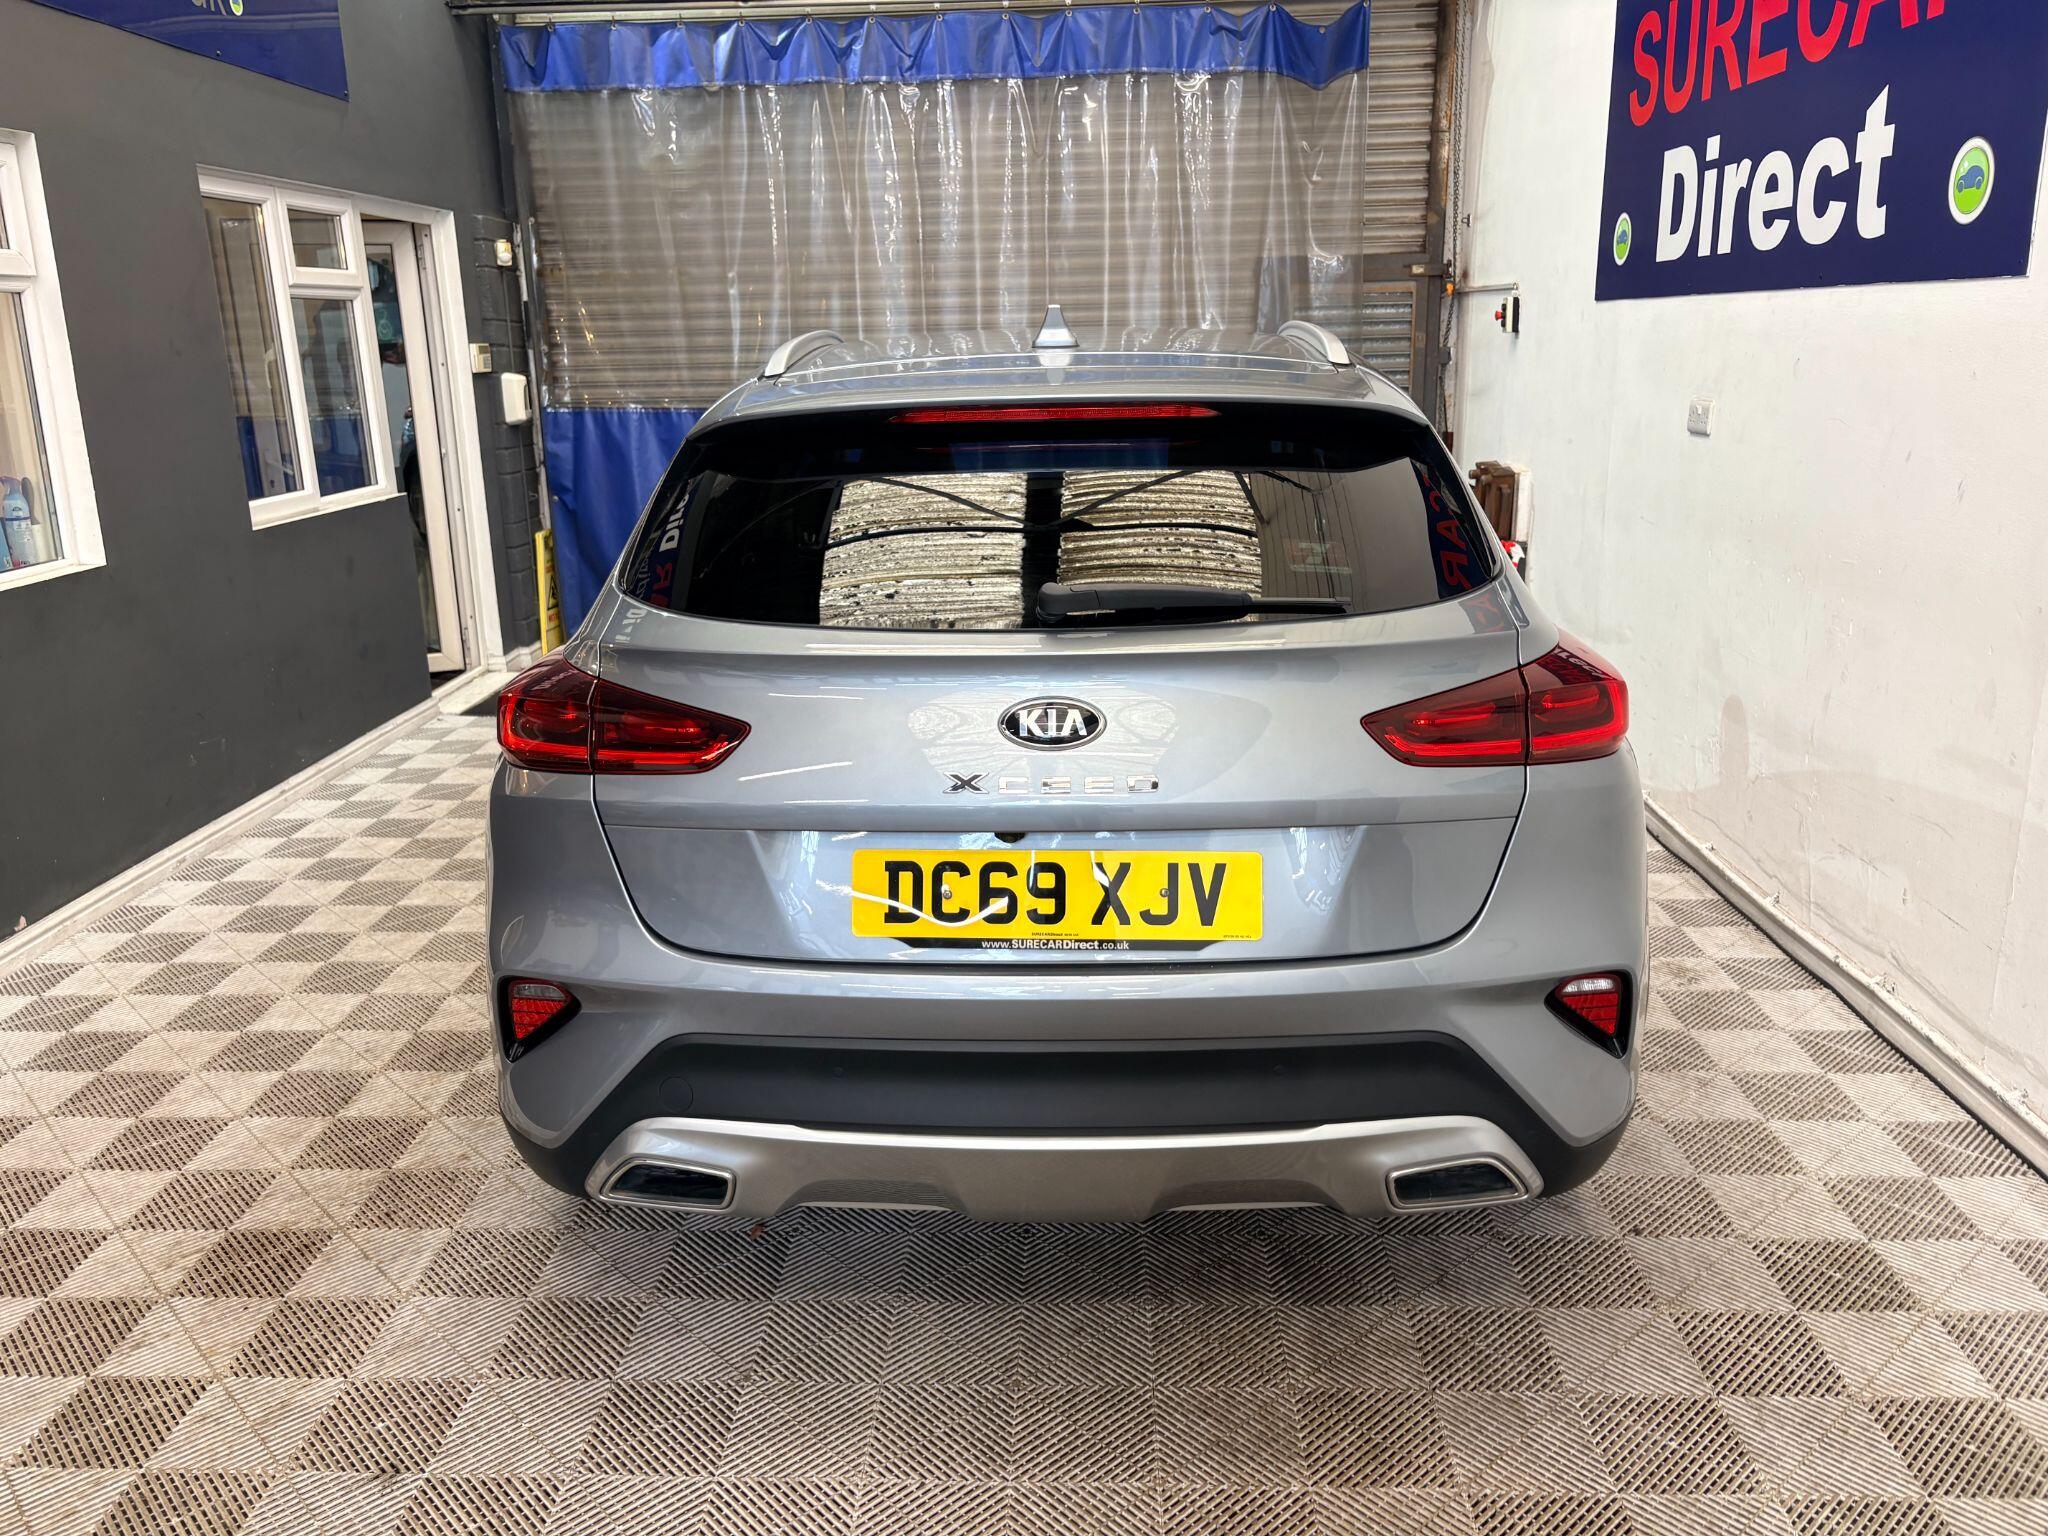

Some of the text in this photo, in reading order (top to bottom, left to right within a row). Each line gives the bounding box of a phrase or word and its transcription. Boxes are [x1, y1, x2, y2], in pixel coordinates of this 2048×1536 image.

[1629, 0, 1946, 127] SUREC
[1655, 84, 1896, 263] Direct
[1018, 708, 1088, 737] KIA
[942, 771, 1160, 795] XCEED
[884, 860, 1227, 926] DC69 XJV
[981, 938, 1130, 950] www.SURECARDirect.co.uk
